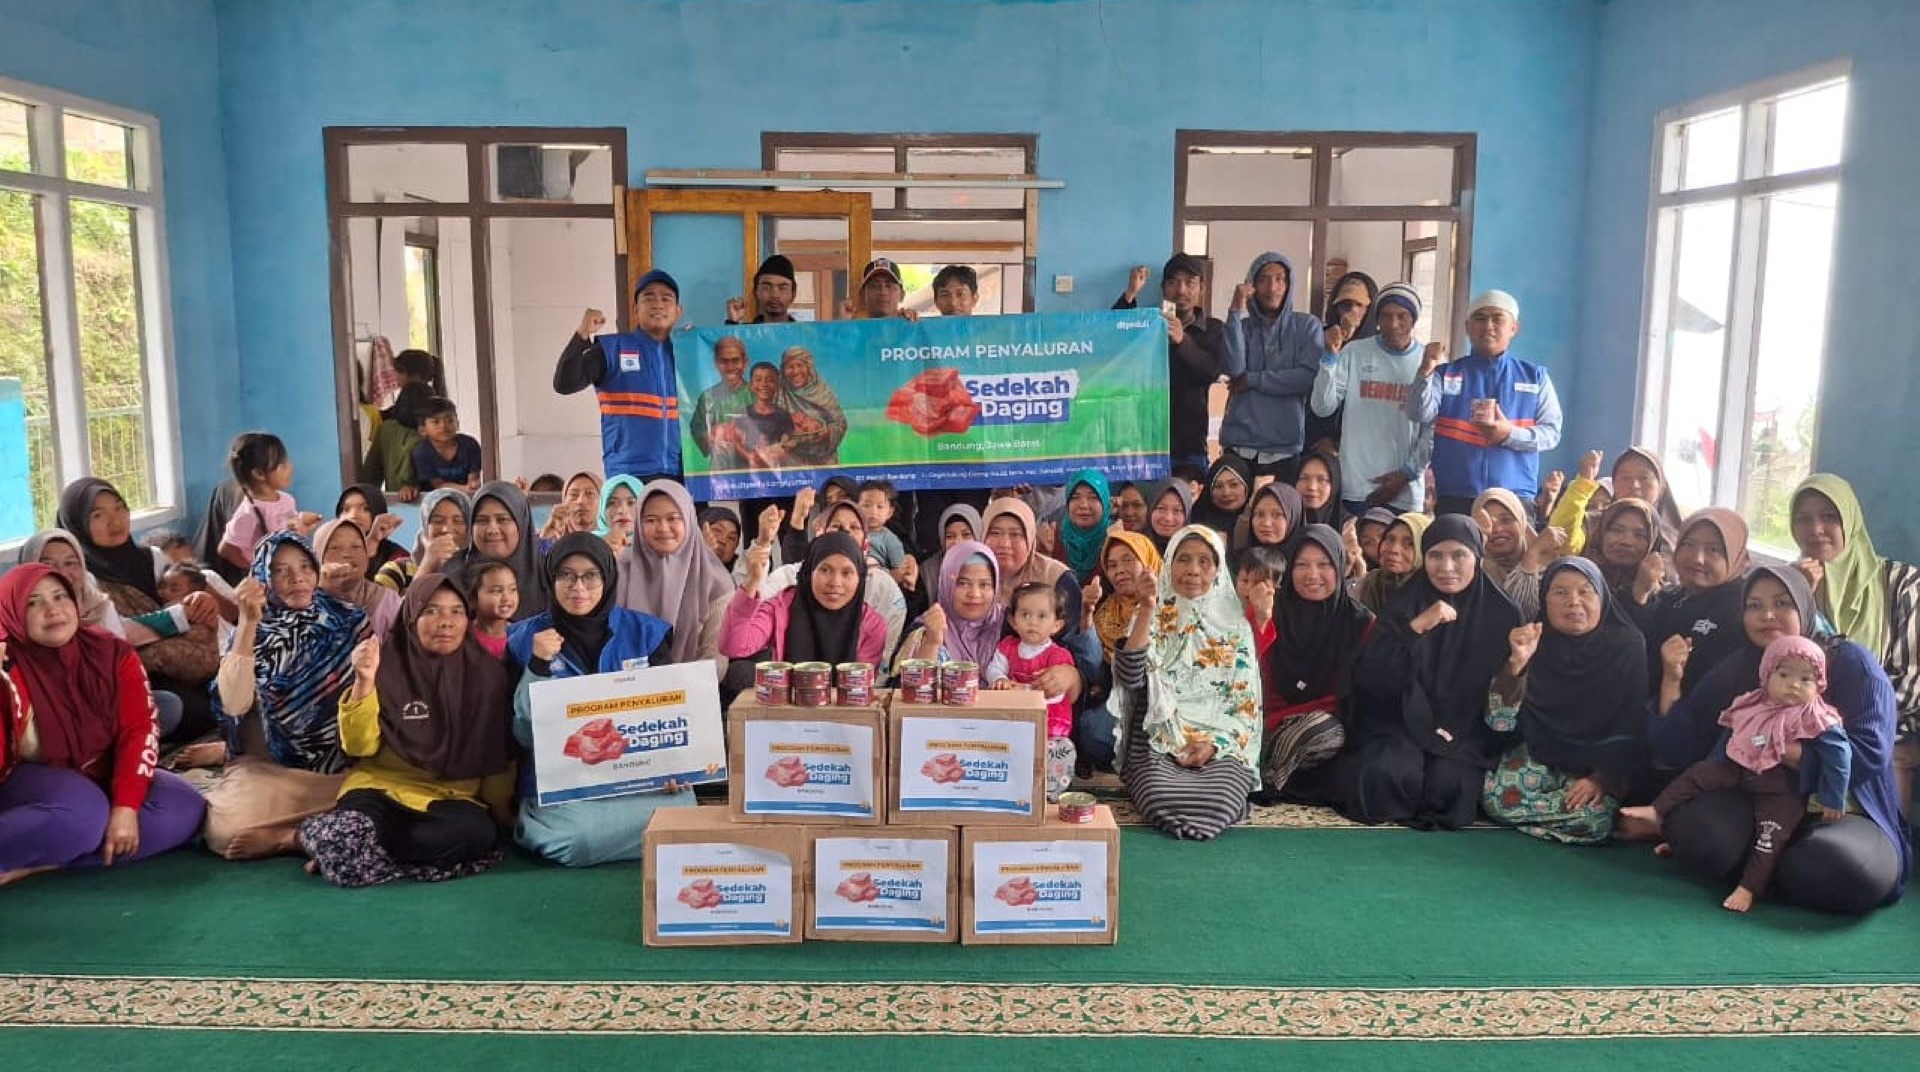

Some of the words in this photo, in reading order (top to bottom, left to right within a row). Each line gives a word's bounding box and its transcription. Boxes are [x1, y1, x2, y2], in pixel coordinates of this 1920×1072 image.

[881, 345, 970, 362] PROGRAM
[975, 340, 1093, 358] PENYALURAN
[965, 376, 1070, 397] Sedekah
[981, 398, 1063, 421] Daging
[570, 702, 618, 715] PROGRAM
[620, 694, 682, 709] PENYALURAN
[617, 716, 688, 736] Sedekah
[629, 732, 685, 748] Daging
[804, 763, 851, 772] Sedekah
[960, 759, 1009, 769] Sedekah
[717, 884, 767, 892] Sedekah
[874, 878, 923, 888] Sedekah
[1033, 880, 1082, 889] Sedekah
